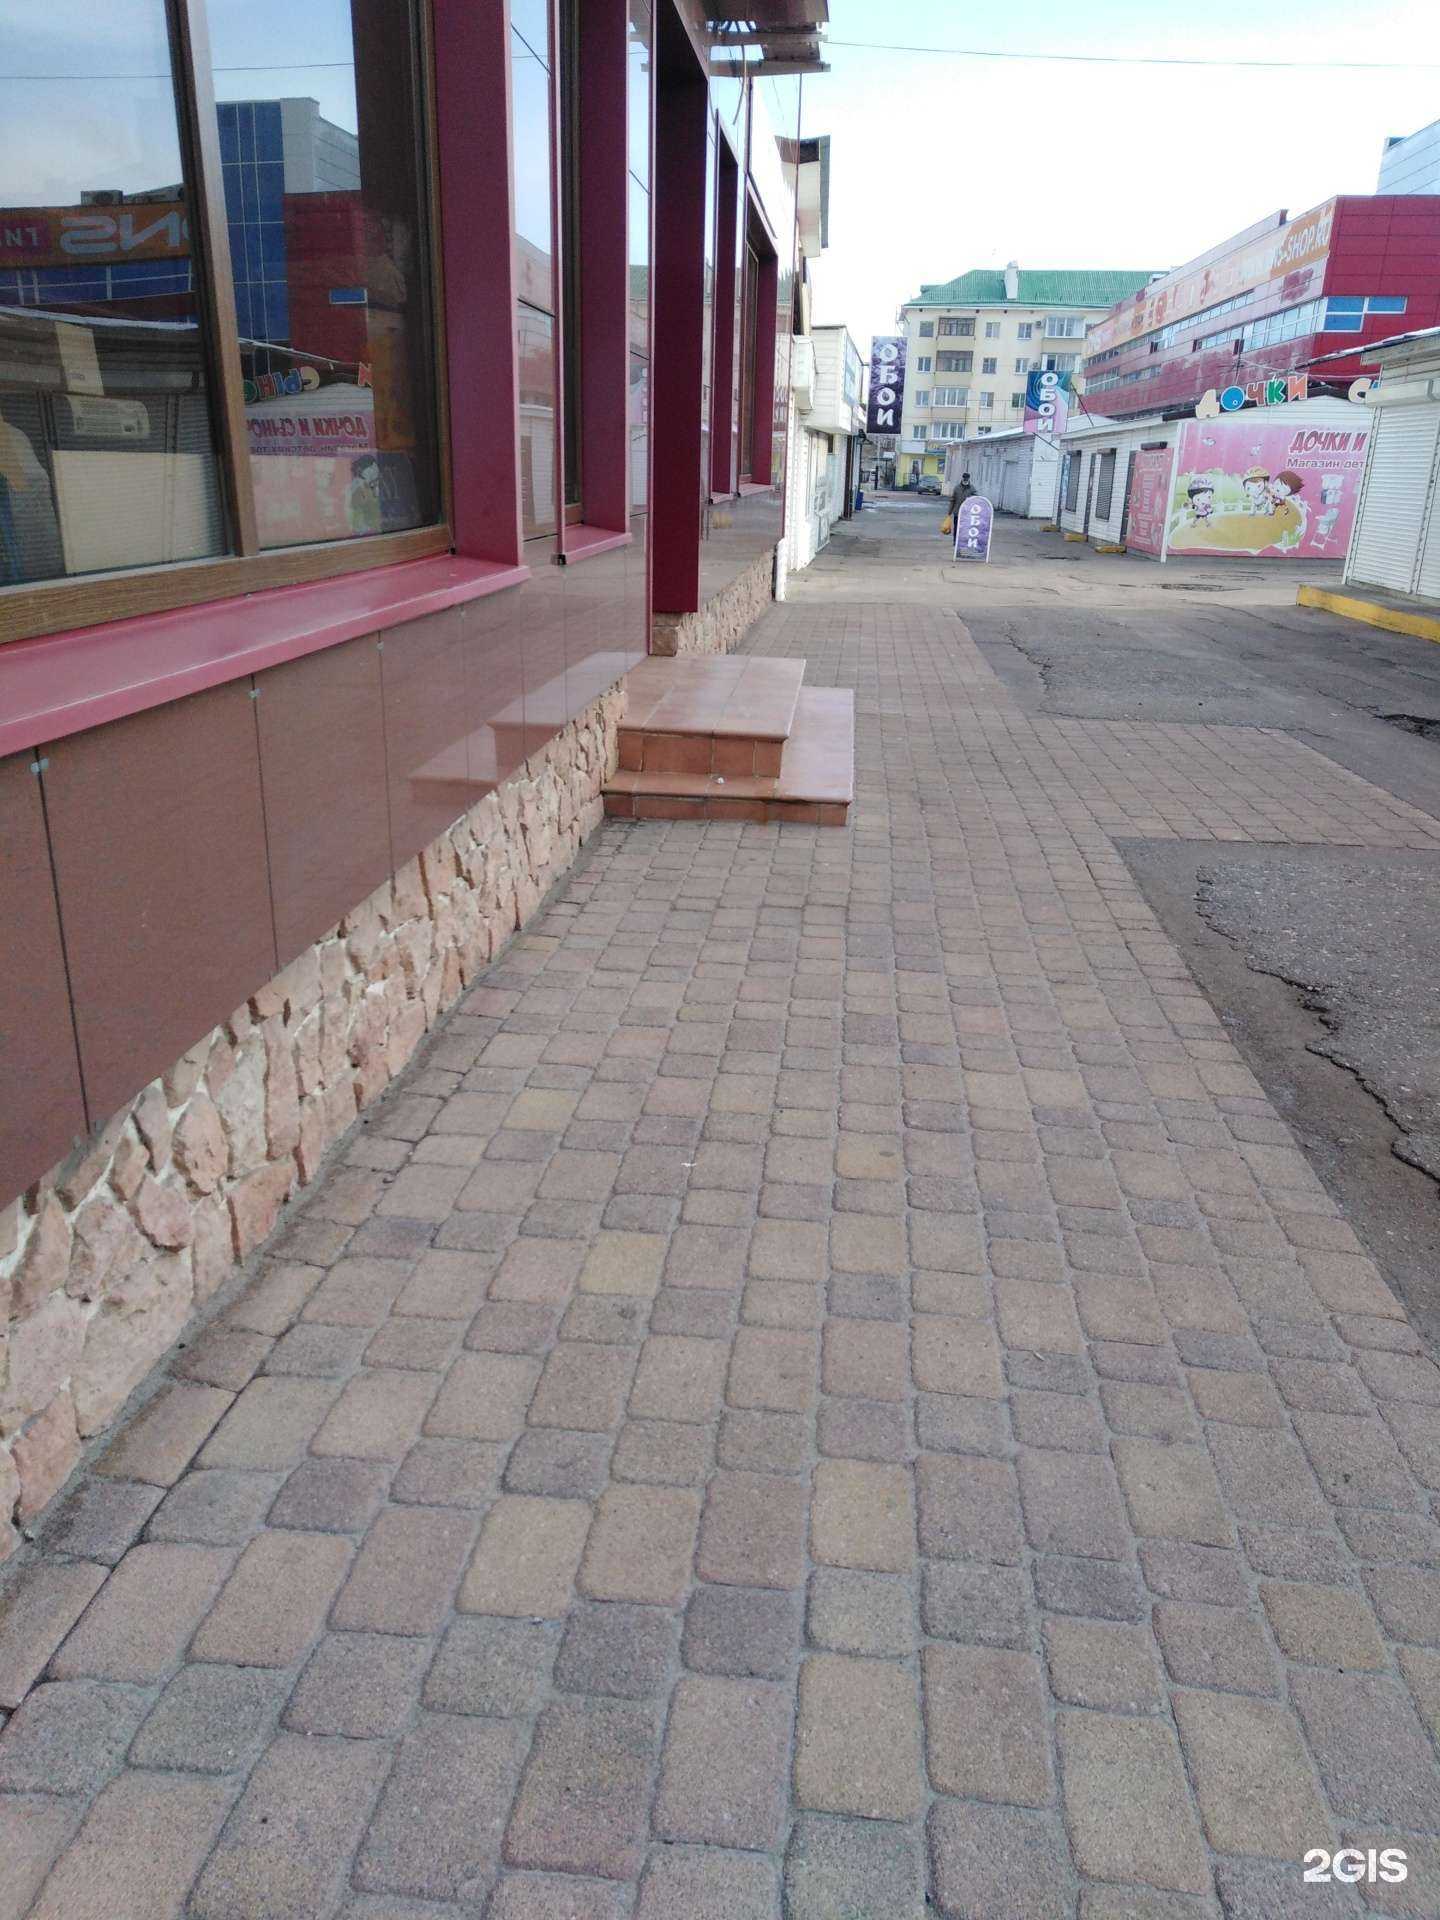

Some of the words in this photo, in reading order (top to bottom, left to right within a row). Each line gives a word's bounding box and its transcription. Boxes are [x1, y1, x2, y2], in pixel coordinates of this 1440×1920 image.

[876, 343, 899, 427] ОБОИ
[1037, 373, 1059, 432] ОБОИ
[1287, 458, 1340, 469] Магазин
[1289, 430, 1347, 453] ДОЧКИ
[1350, 432, 1368, 451] И
[967, 504, 982, 548] ОБОИ
